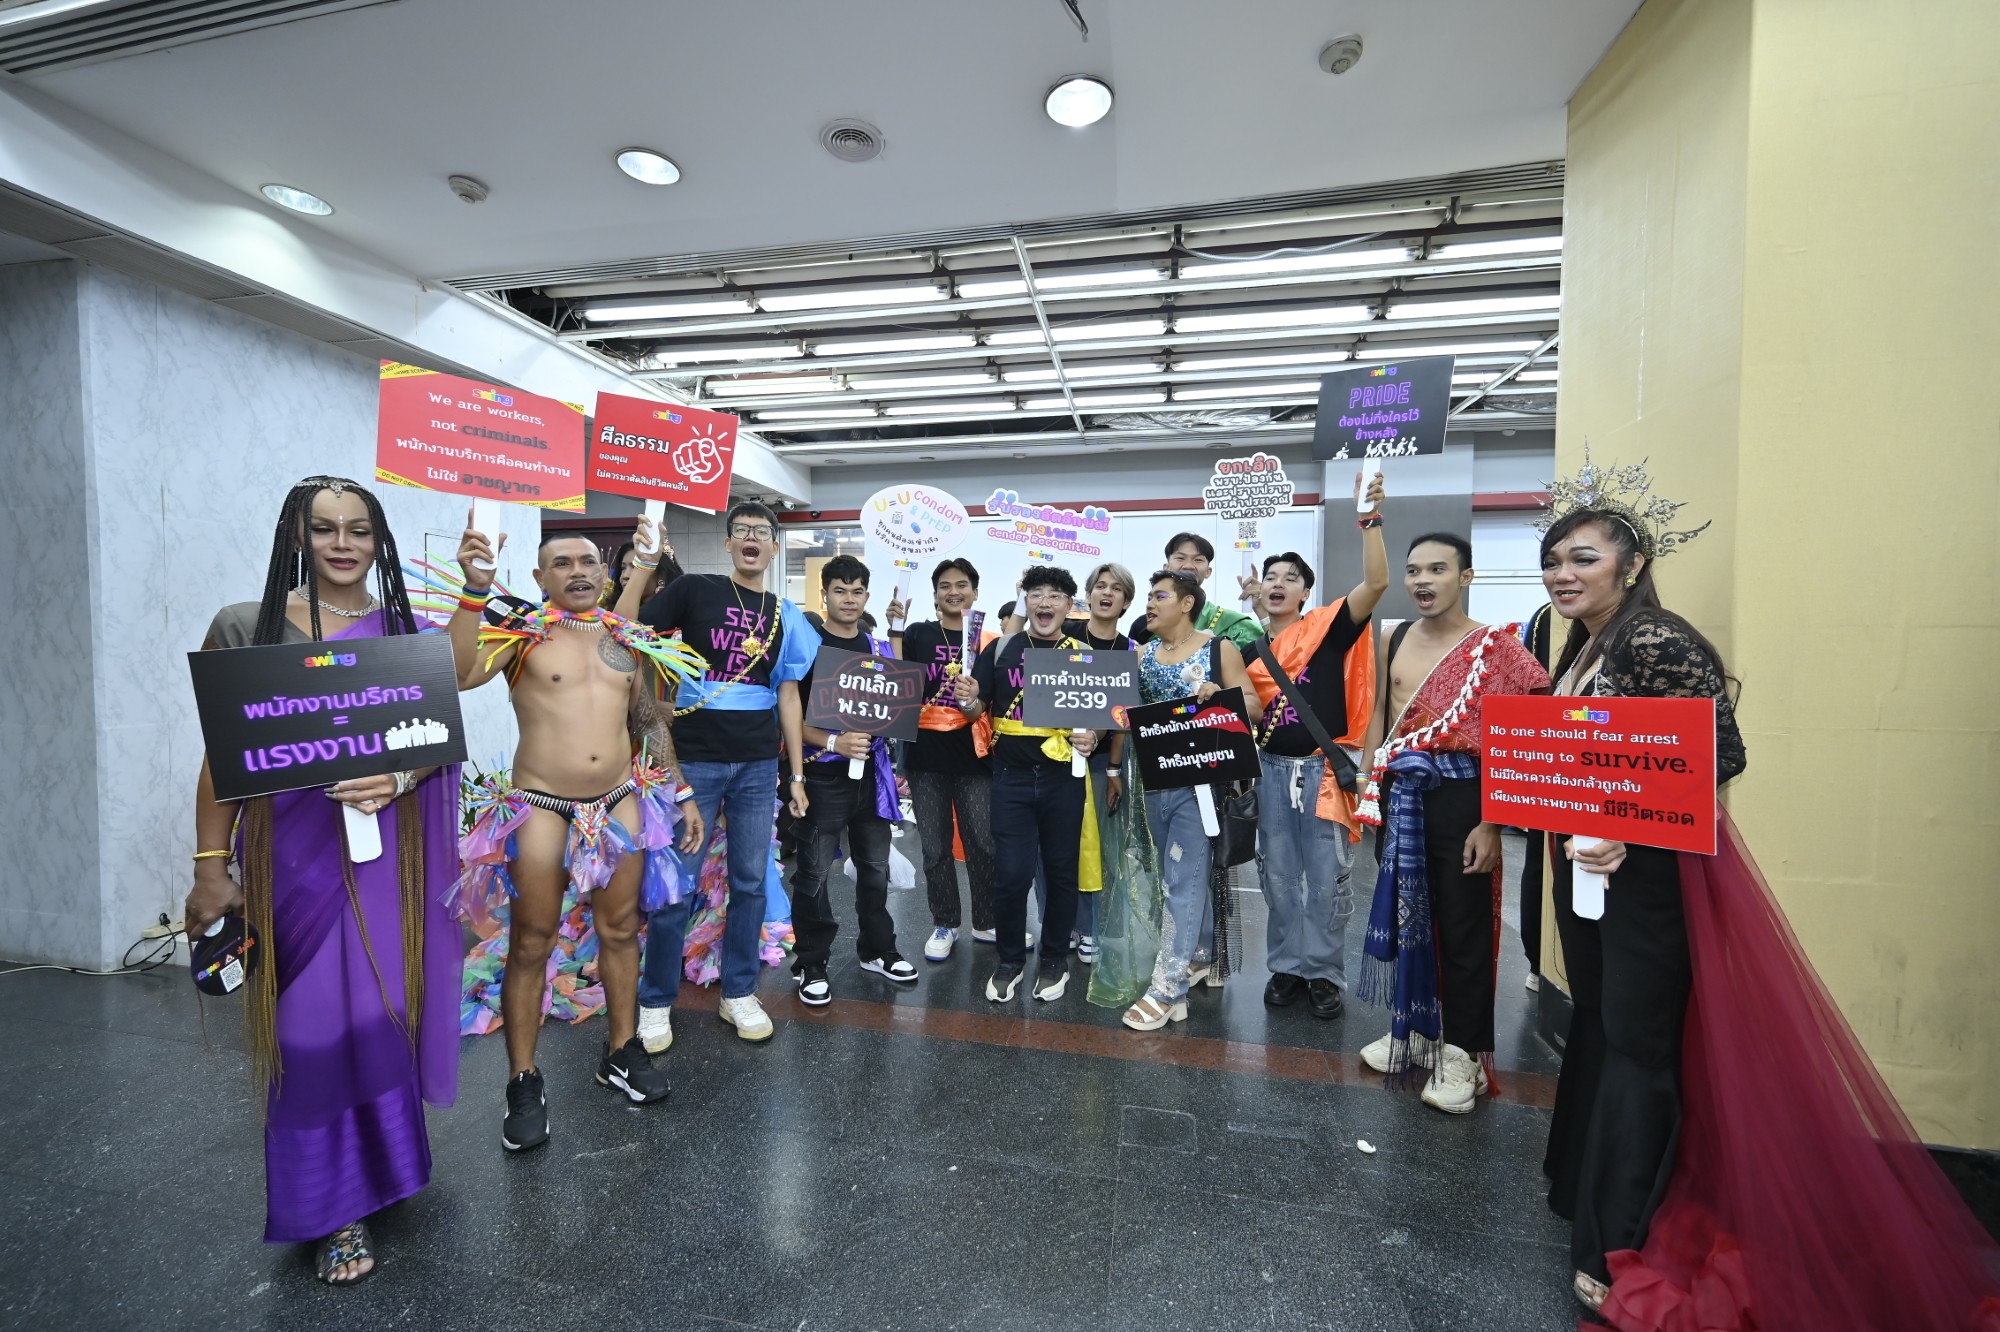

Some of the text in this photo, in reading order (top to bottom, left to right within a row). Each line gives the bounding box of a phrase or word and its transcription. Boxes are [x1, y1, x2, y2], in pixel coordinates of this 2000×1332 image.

[1370, 366, 1397, 376] swing
[473, 388, 513, 406] swing
[1350, 381, 1411, 409] PRIDE
[428, 392, 545, 427] We are workers,
[653, 410, 682, 424] swing
[1339, 408, 1420, 428] ต้องไม่ทิ้งใครไว้
[431, 420, 551, 450] not criminals.
[600, 426, 670, 454] ศีลธรรม
[1355, 427, 1398, 440] ข้างหลัง
[396, 438, 570, 477] พนักงานบริการคือคนทำงาน
[599, 453, 628, 464] ของคุณ
[1218, 456, 1278, 475] ยกเลิก
[426, 466, 541, 496] ไม่ใช่ อาชญากร
[596, 469, 689, 492] ไม่ควรมาตัดสินชีวิตคนอื่น
[1214, 473, 1283, 486] พรบ.ป้องกัน
[1206, 484, 1291, 498] และปราบปราม
[1208, 494, 1289, 510] การค้าประเวณี
[988, 498, 1110, 532] รับรองอัตลักษณ์
[1221, 507, 1275, 519] พ.ศ.2539
[1015, 521, 1077, 541] ทางเพศ
[988, 527, 1100, 556] Gender Recognition
[1234, 538, 1260, 549] swing
[894, 558, 918, 570] swing
[1028, 550, 1053, 561] swing
[724, 607, 767, 633] SEX
[304, 651, 356, 668] swing
[727, 653, 749, 672] IS
[935, 645, 960, 662] SE
[839, 673, 898, 696] ยกเลิก
[1031, 670, 1130, 687] การค้าประเวณี
[244, 684, 423, 720] พนักงานบริการ
[838, 698, 892, 720] พ.ร.บ.
[1054, 691, 1107, 709] 2539
[1172, 704, 1196, 715] swing
[1139, 712, 1238, 738] สิทธิพนักงานบริการ
[1563, 706, 1610, 724] swing
[1490, 725, 1679, 745] No one should fear arrest
[244, 732, 382, 772] แรงงาน
[1158, 749, 1235, 769] สิทธิมนุษยชน
[1490, 747, 1694, 774] for trying to survive.
[1490, 768, 1641, 794] ไม่มีใครควรต้องกลัวถูกจับ
[1490, 790, 1695, 826] เพียงเพราะพยายาม มีชีวิตรอด
